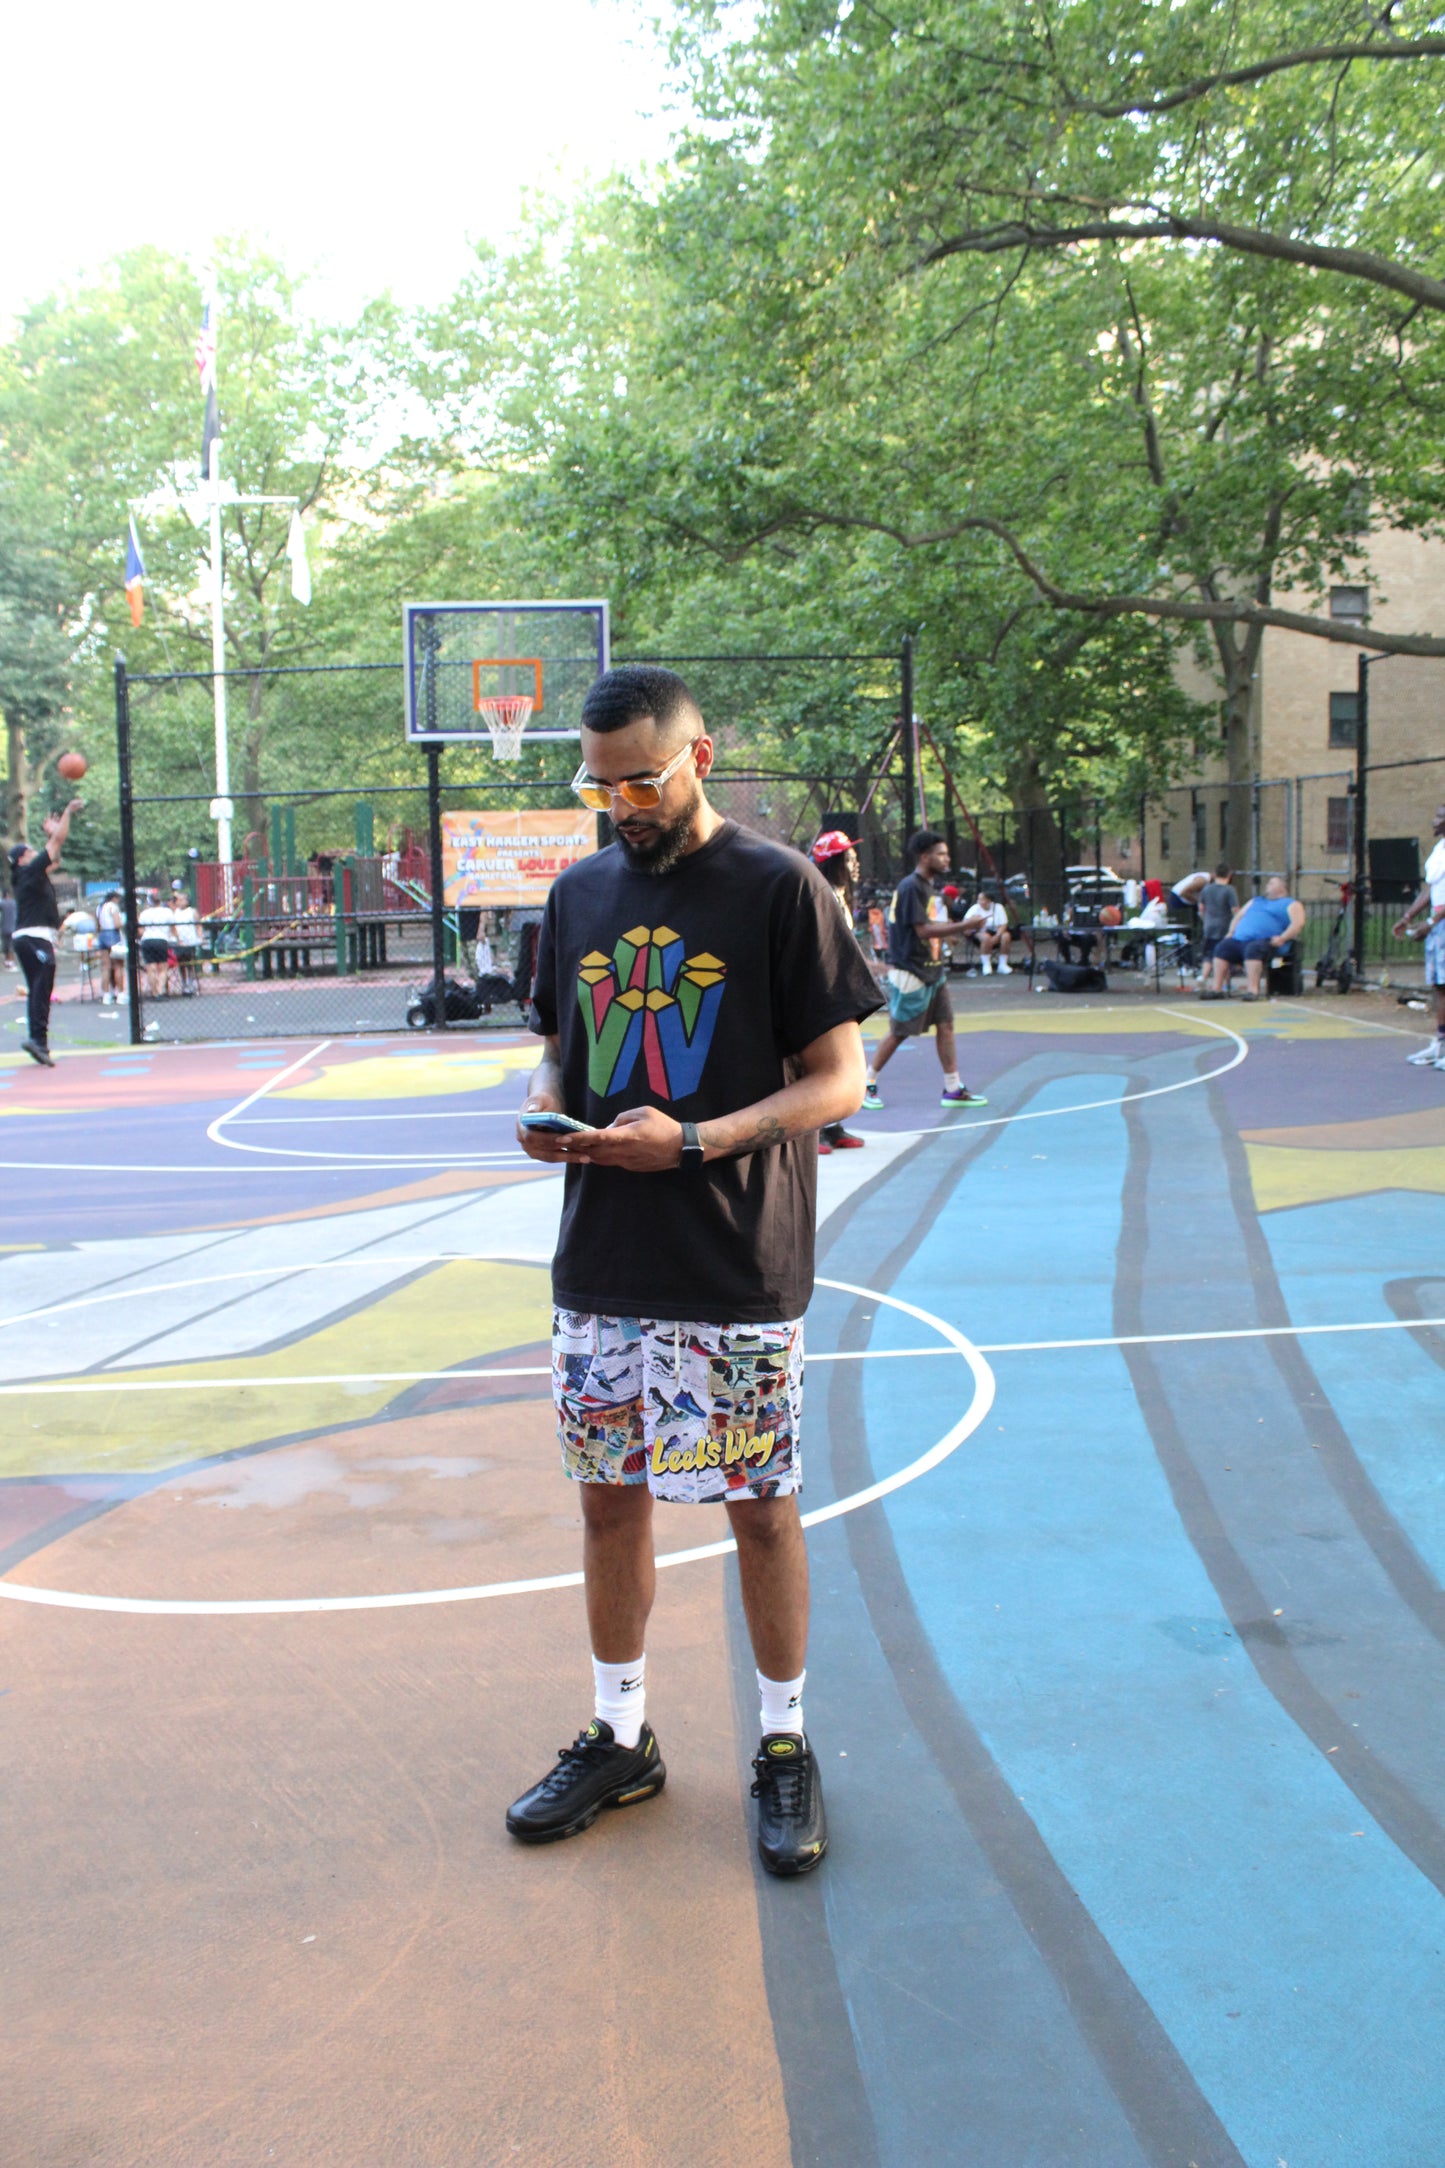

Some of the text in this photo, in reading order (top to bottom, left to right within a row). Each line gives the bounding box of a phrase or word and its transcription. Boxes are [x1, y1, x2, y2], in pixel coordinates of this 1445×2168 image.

[540, 834, 588, 846] SPORTS
[456, 859, 515, 871] CARVER
[518, 858, 556, 870] LOVE
[724, 1428, 776, 1468] Way
